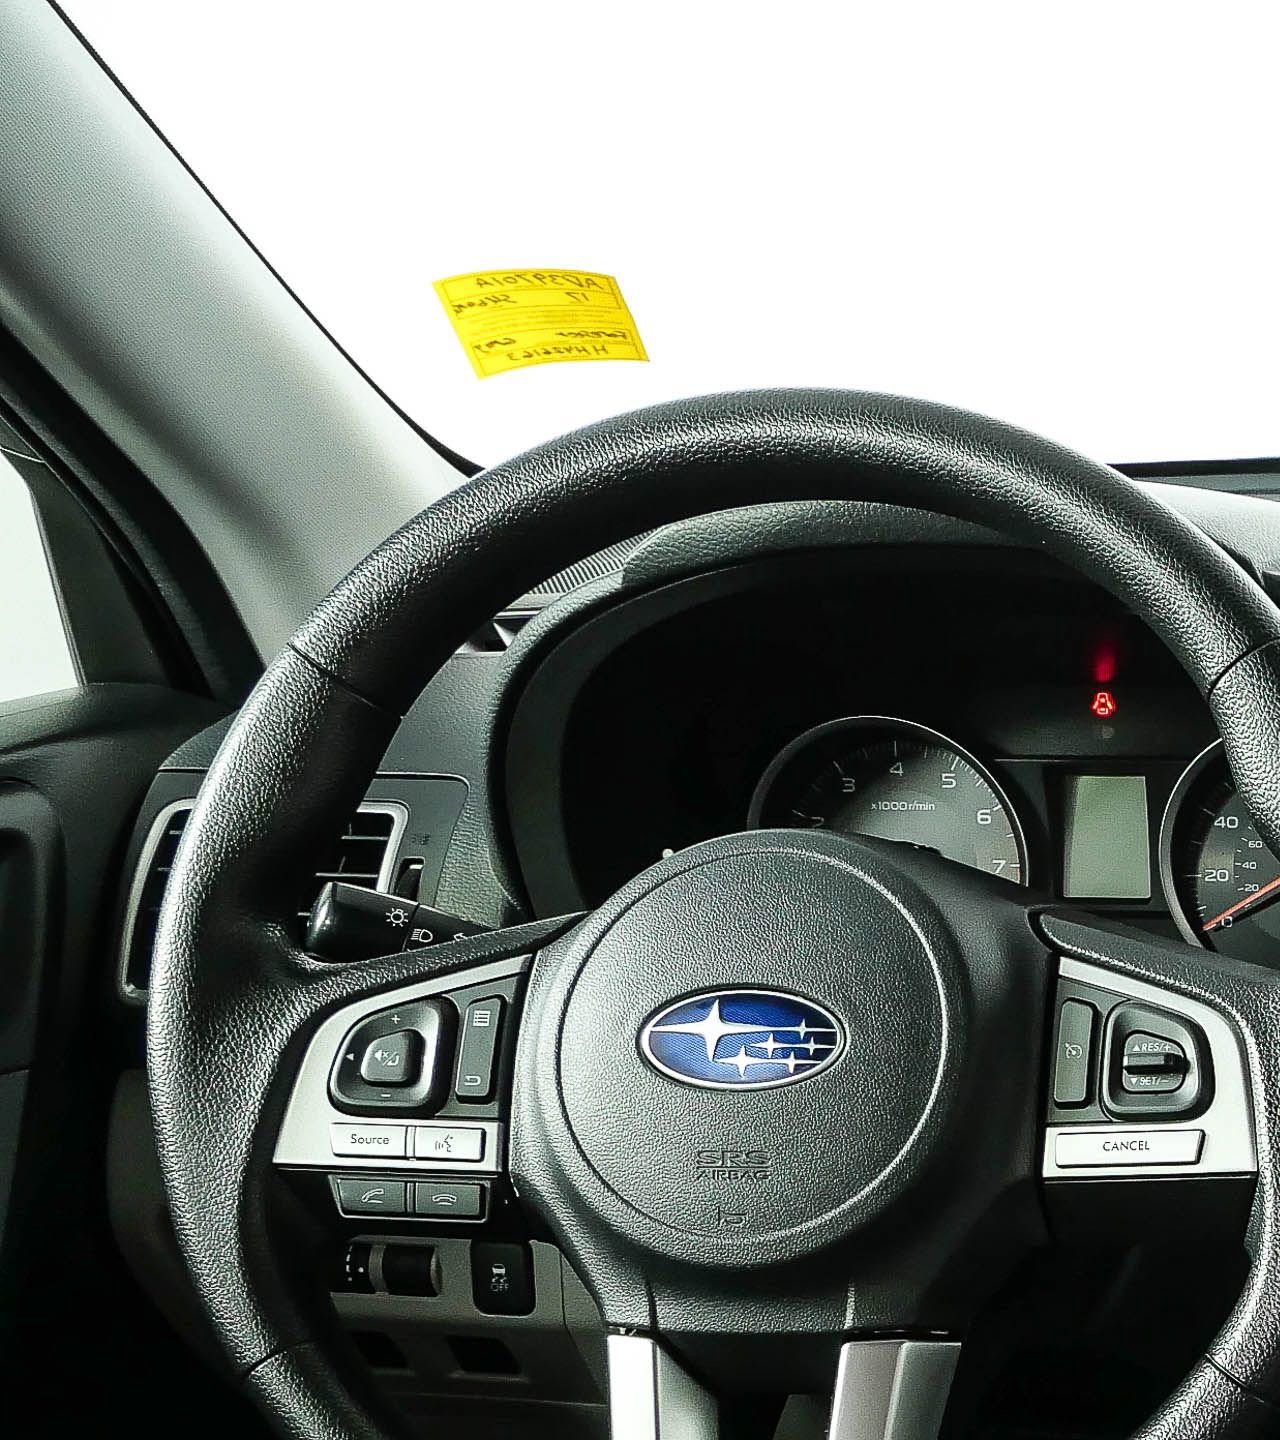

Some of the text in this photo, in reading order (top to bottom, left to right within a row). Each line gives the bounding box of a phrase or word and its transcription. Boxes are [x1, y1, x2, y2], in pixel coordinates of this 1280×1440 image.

[889, 762, 904, 777] 4
[842, 778, 856, 792] 3
[941, 773, 957, 788] 5
[976, 809, 992, 824] 6
[1213, 816, 1239, 829] 40
[992, 860, 1006, 874] 7
[1242, 862, 1257, 870] 40
[1204, 869, 1229, 881] 20
[350, 1133, 390, 1145] Source
[1102, 1140, 1150, 1151] CANCEL
[696, 1149, 771, 1165] SRS
[696, 1169, 771, 1180] AIRBAG
